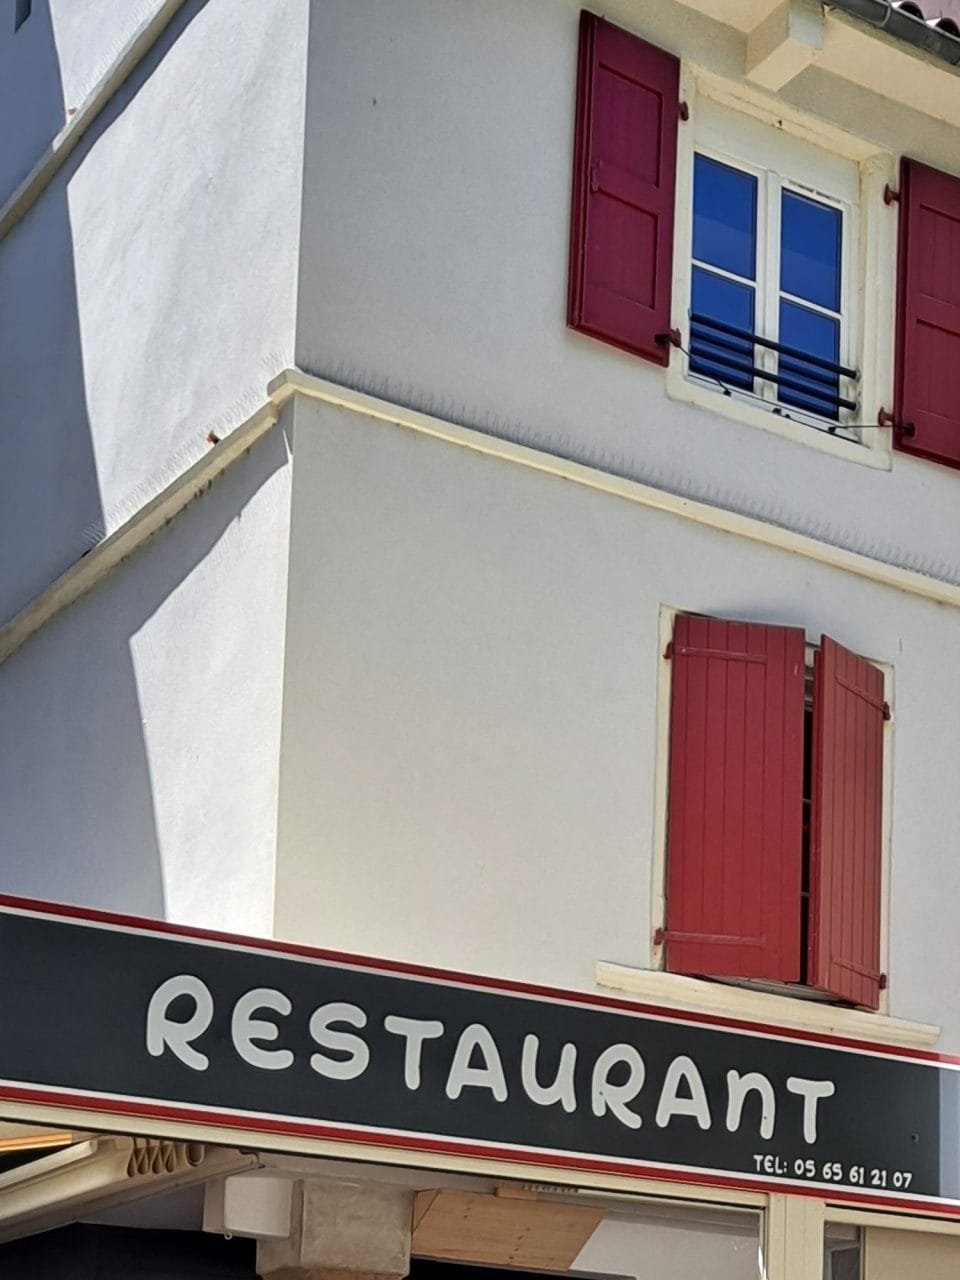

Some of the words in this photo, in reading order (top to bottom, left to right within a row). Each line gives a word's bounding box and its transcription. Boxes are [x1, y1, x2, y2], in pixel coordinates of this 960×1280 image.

[753, 1154, 788, 1174] TEL:
[794, 1158, 816, 1178] 05
[822, 1162, 843, 1181] 65
[849, 1165, 865, 1184] 61
[870, 1168, 887, 1187] 21
[892, 1171, 913, 1189] 07
